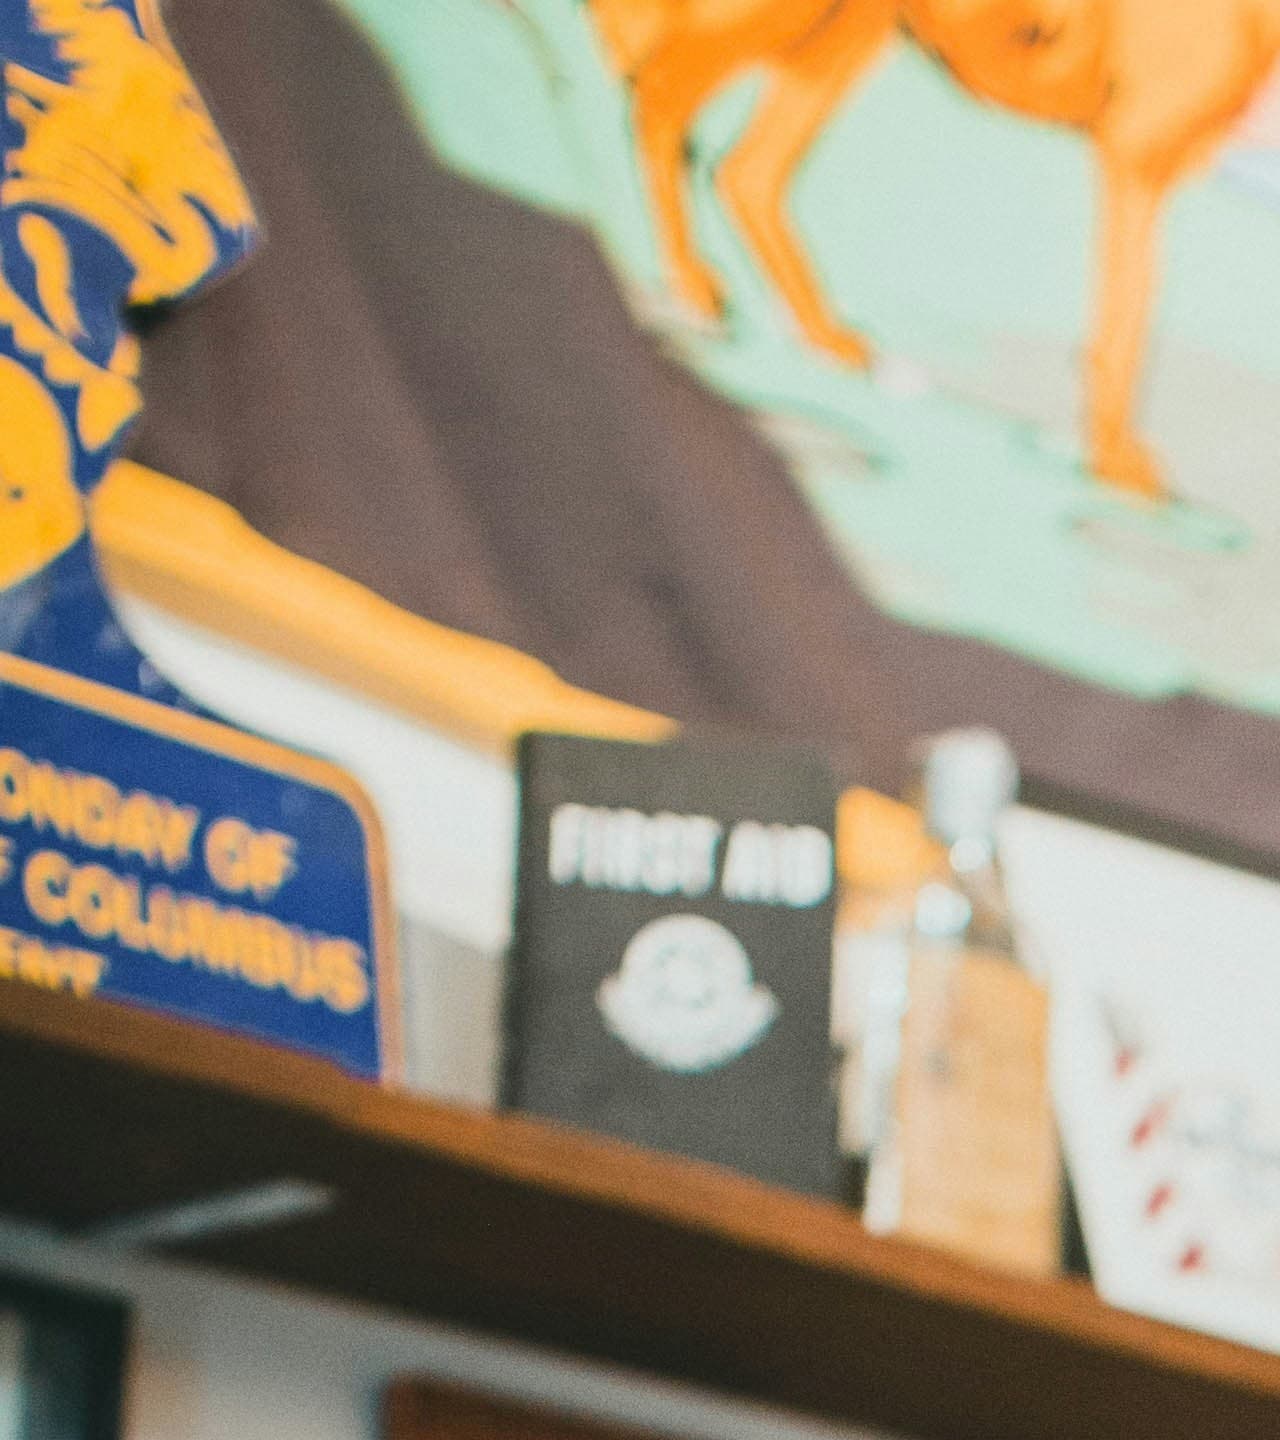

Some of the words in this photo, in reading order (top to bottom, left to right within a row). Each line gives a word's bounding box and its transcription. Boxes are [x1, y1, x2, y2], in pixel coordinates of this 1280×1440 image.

[203, 816, 298, 898] OF
[548, 801, 720, 898] FIRST
[721, 819, 834, 910] AID
[23, 849, 369, 1013] COLUMBUS
